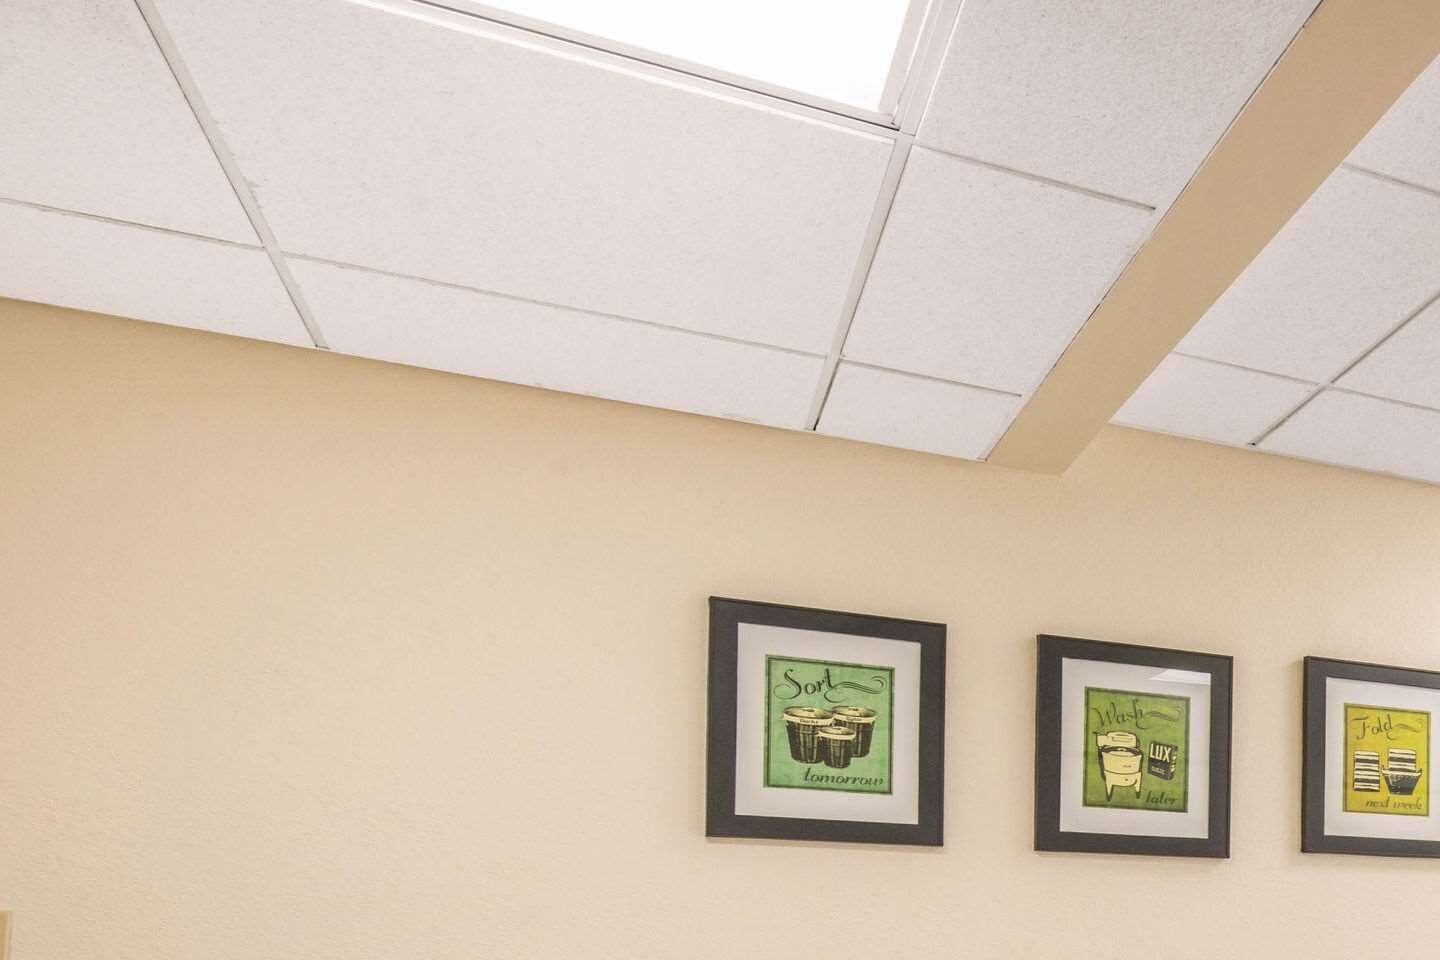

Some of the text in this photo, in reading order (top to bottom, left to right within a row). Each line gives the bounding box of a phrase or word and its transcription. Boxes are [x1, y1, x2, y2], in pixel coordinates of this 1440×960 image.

[774, 668, 846, 702] Sort
[1092, 699, 1150, 728] Wash
[1351, 713, 1398, 740] Fold
[1149, 743, 1171, 762] LUX
[804, 767, 883, 786] tomorrow
[1365, 796, 1391, 808] next
